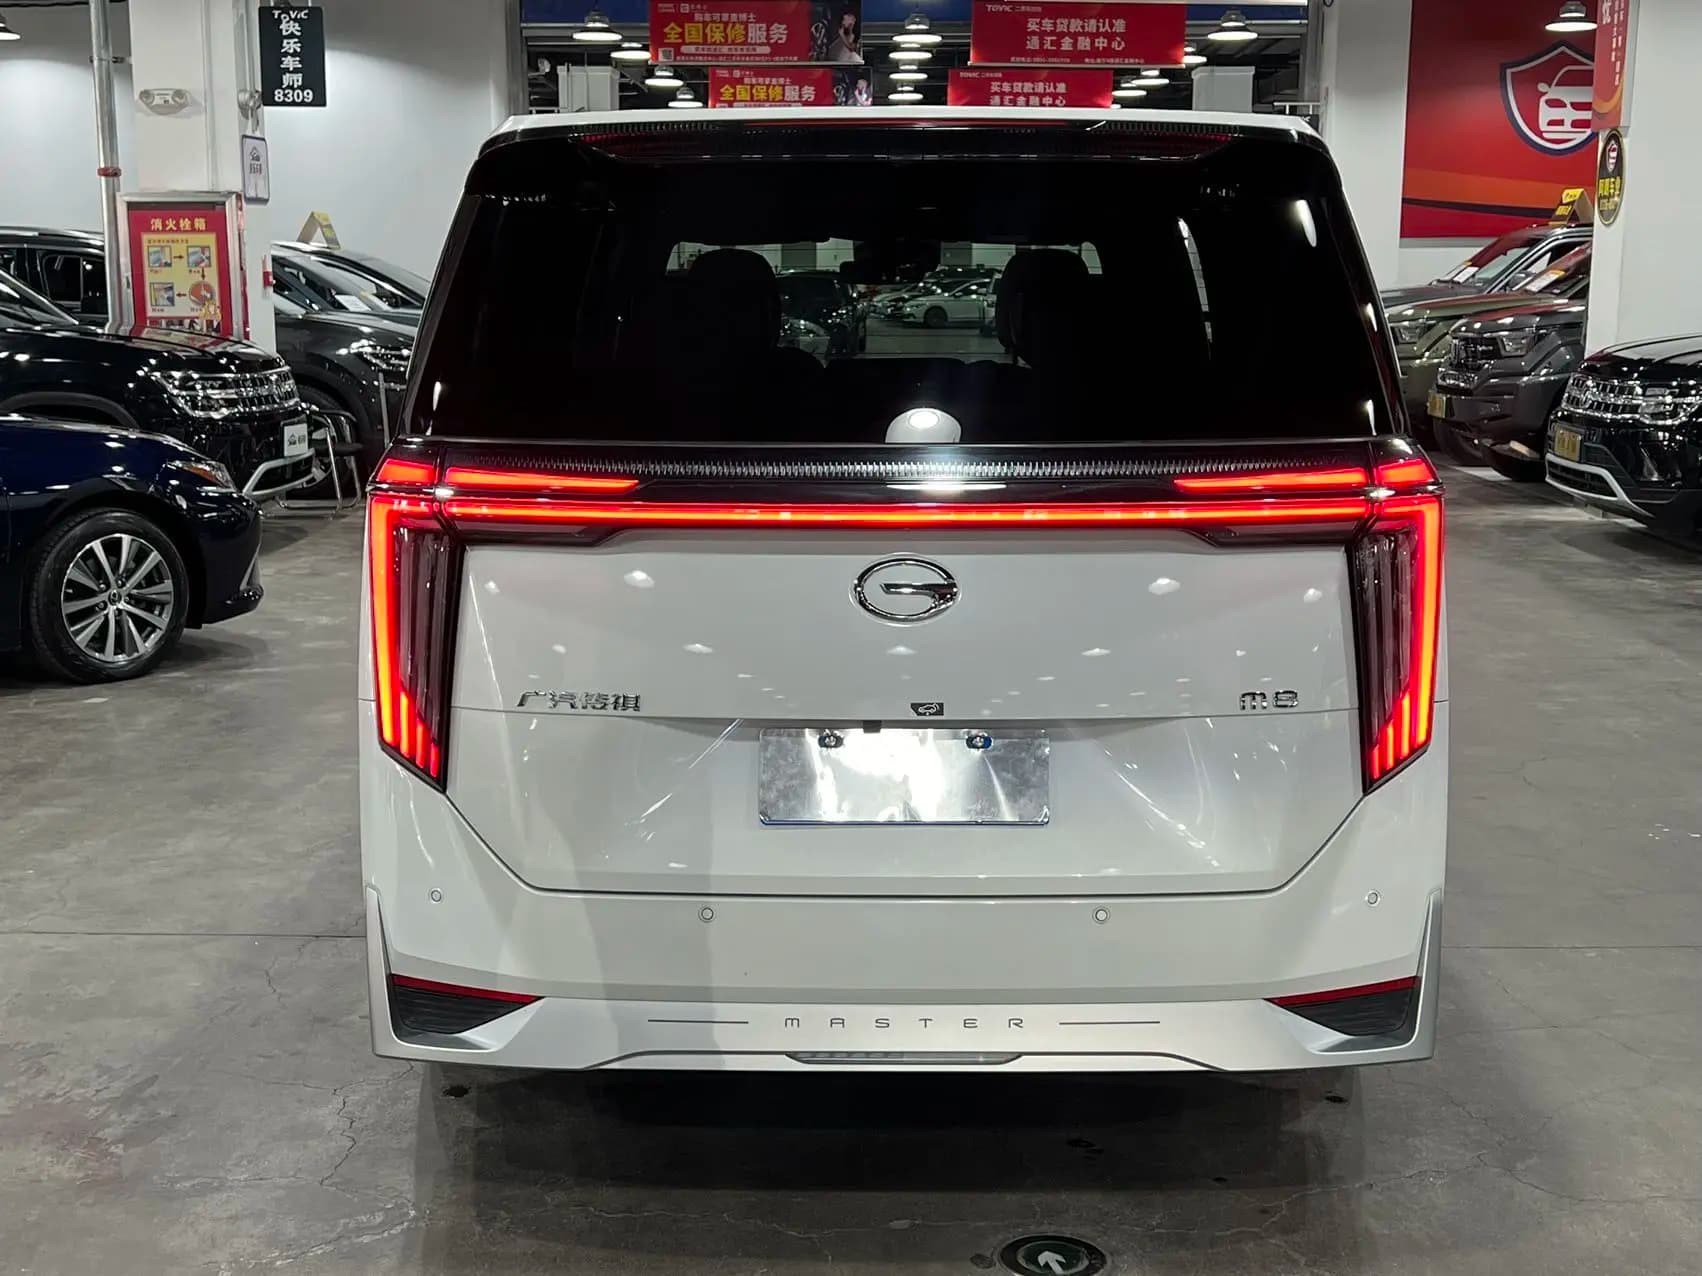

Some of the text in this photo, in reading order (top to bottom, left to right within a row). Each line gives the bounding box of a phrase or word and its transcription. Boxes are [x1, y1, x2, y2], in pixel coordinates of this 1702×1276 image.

[663, 22, 788, 44] 全国保修服务
[1026, 18, 1127, 33] 买车贷款请认准
[1025, 36, 1125, 51] 通汇金融中心
[280, 20, 303, 88] 快乐车师
[274, 89, 313, 102] 8309
[720, 84, 817, 102] 全国保修服务
[150, 218, 207, 231] 消火栓箱
[785, 1017, 1024, 1029] MASTER
